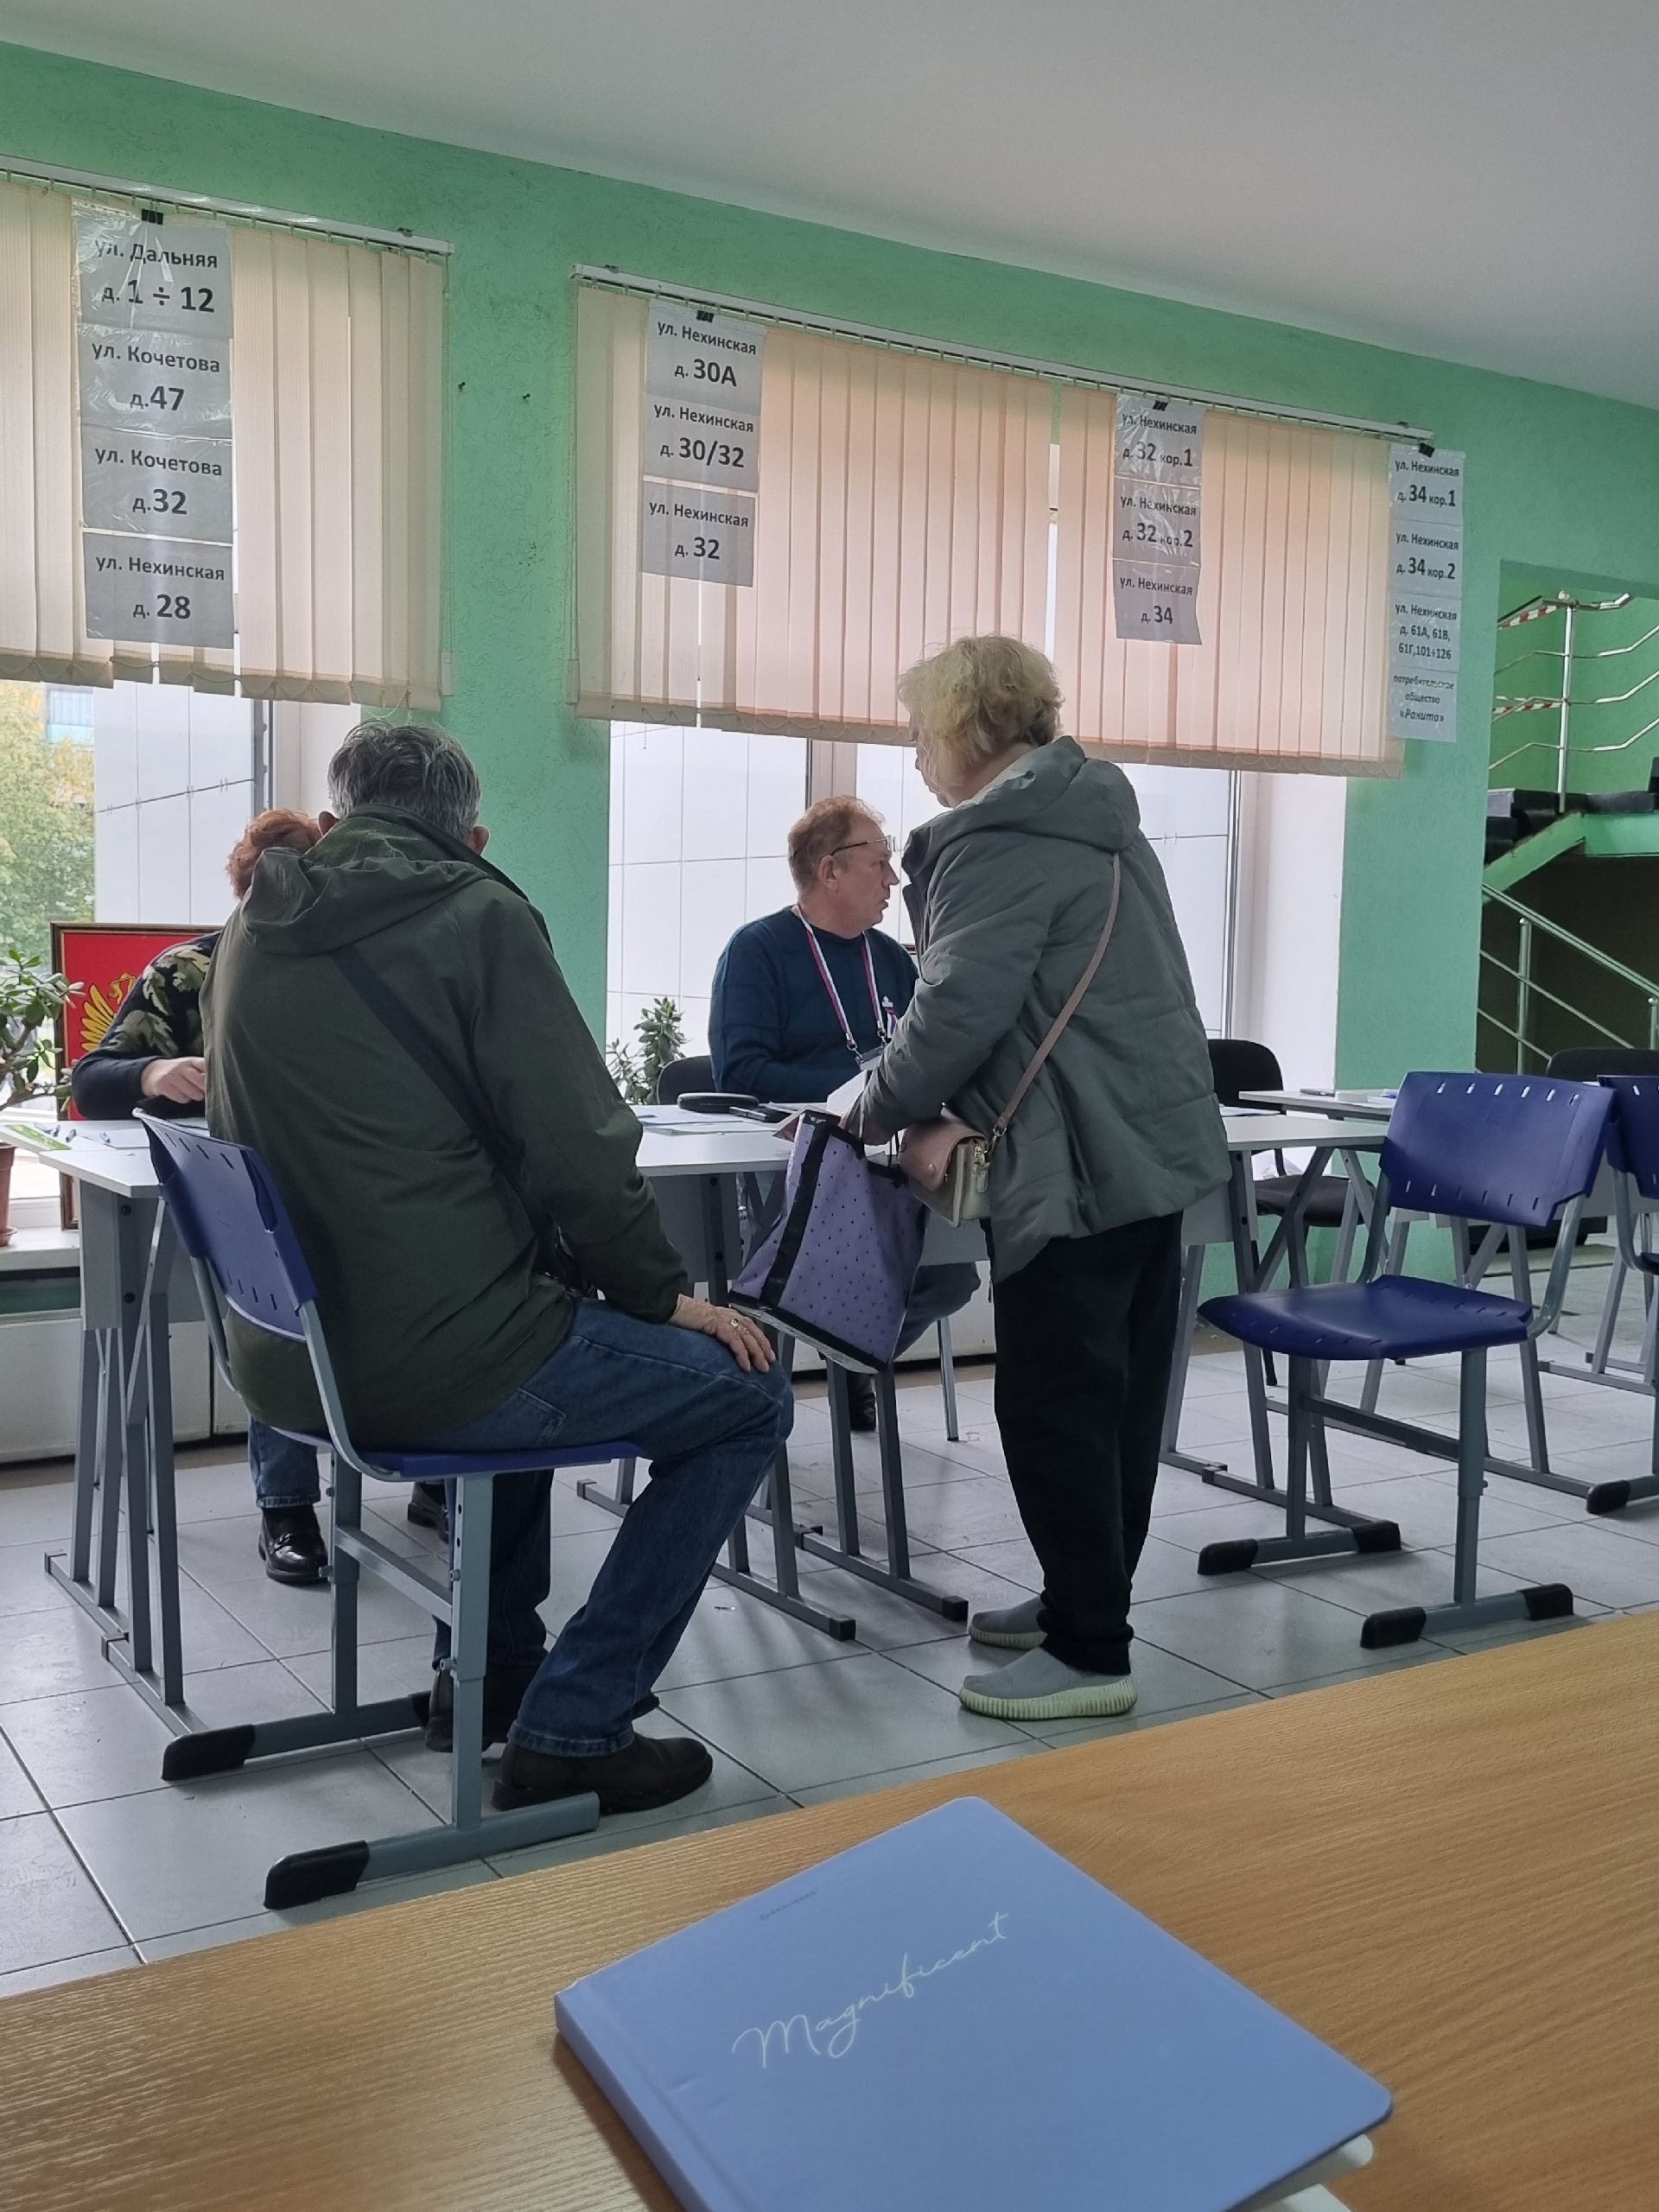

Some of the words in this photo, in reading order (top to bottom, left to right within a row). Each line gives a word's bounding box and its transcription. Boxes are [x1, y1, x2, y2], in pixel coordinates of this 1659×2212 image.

[95, 240, 124, 257] ул.
[130, 243, 218, 269] Дальняя
[102, 287, 121, 304] д.
[128, 278, 143, 304] 1
[180, 286, 215, 313] 12
[658, 321, 677, 337] ул.
[683, 325, 757, 355] Нехинская
[92, 343, 121, 359] ул.
[128, 346, 220, 373] Кочетова
[674, 365, 690, 378] д.
[693, 358, 737, 387] 30А
[653, 404, 674, 418] ул.
[679, 406, 754, 433] Нехинская
[1122, 413, 1137, 425] ул.
[1141, 415, 1198, 435] Нехинская
[95, 448, 124, 465] ул.
[130, 449, 223, 476] Кочетова
[660, 444, 674, 458] д.
[678, 436, 745, 468] 30/32
[1122, 448, 1134, 460] д.
[1136, 441, 1156, 461] 32
[1395, 460, 1409, 472] ул.
[1410, 461, 1459, 477] Нехинская
[1396, 492, 1407, 503] д.
[1408, 484, 1427, 503] 34
[649, 501, 669, 515] ул.
[674, 503, 748, 527] Нехинская
[1120, 496, 1137, 508] ул.
[1139, 496, 1197, 516] Нехинская
[1122, 530, 1134, 542] д.
[1137, 522, 1157, 543] 32
[1396, 532, 1409, 544] ул.
[1411, 532, 1459, 550] Нехинская
[674, 544, 689, 558] д.
[693, 536, 721, 560] 32
[95, 556, 123, 572] ул.
[129, 556, 225, 581] Нехинская
[1408, 556, 1426, 575] 34
[1120, 577, 1135, 589] ул.
[1138, 577, 1193, 596] Нехинская
[133, 603, 150, 619] д.
[156, 593, 192, 620] 28
[1141, 612, 1151, 624] д.
[1154, 605, 1173, 625] 34
[1395, 604, 1408, 615] ул.
[1410, 604, 1457, 620] Нехинская
[1405, 691, 1440, 705] общество
[731, 1910, 1009, 2069] Magnificent
